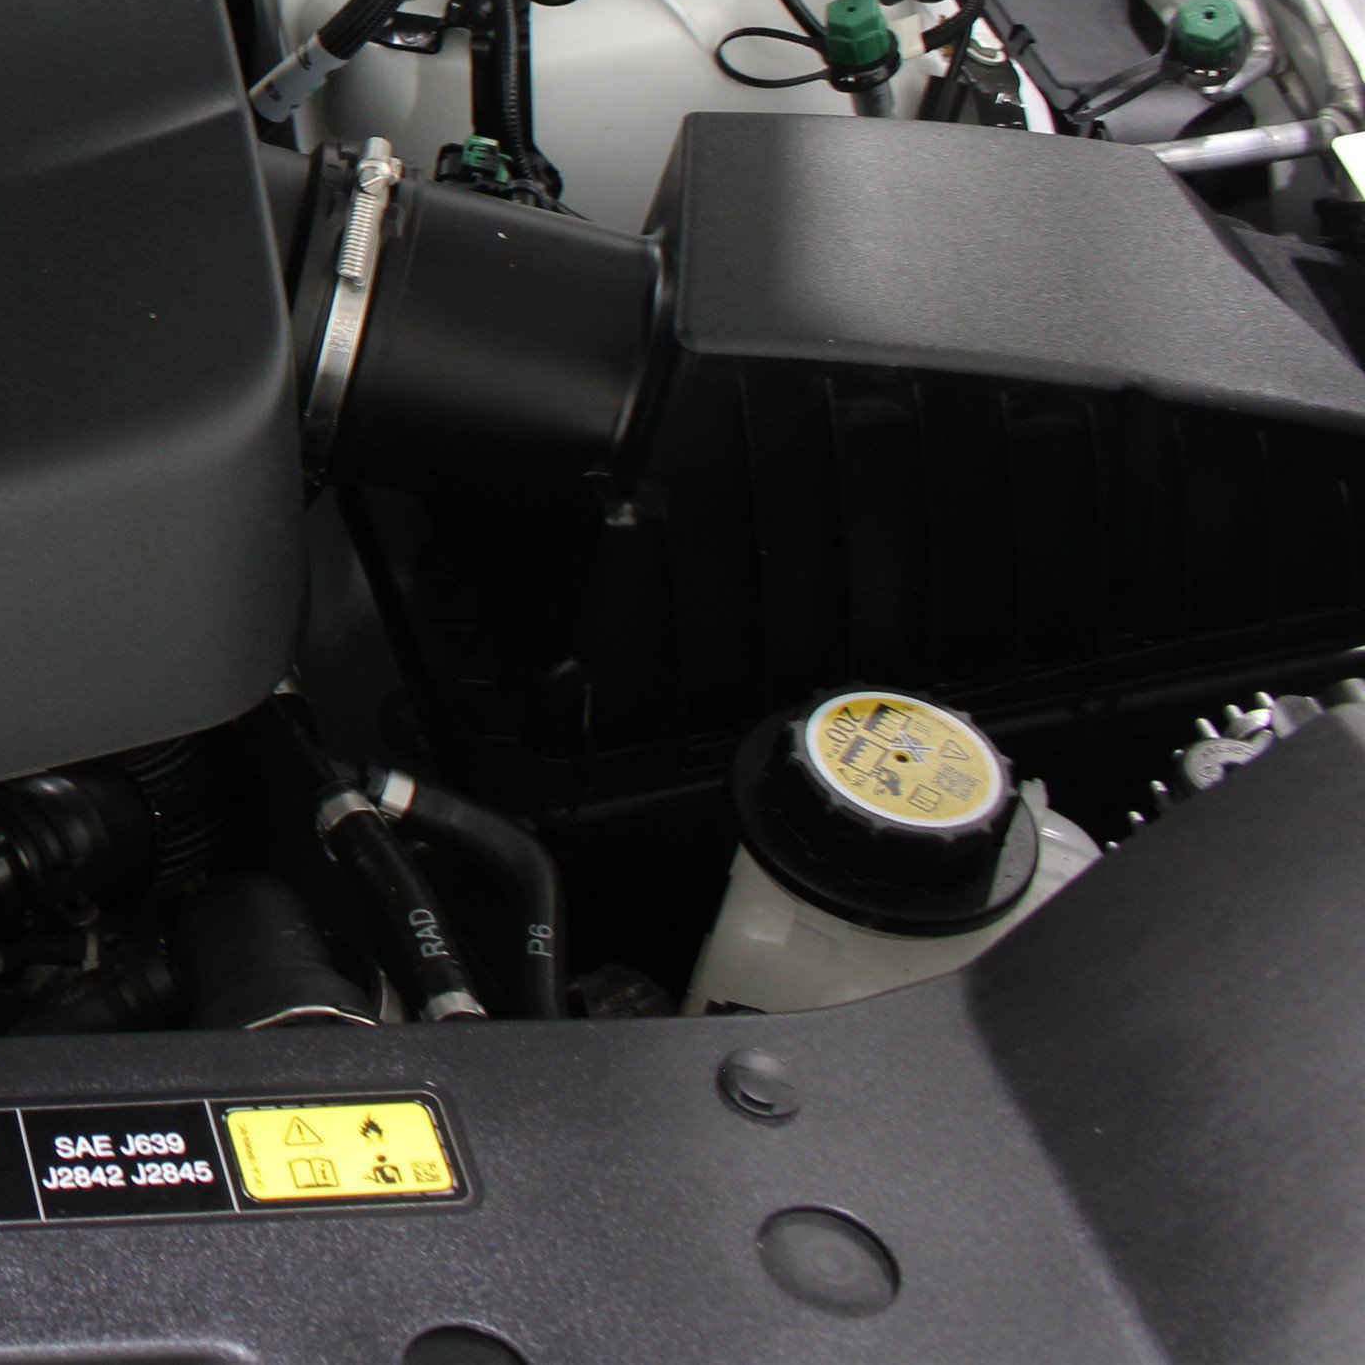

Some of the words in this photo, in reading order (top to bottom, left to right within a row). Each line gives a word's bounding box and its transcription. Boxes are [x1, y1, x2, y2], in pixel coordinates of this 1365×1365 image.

[825, 706, 865, 744] 200
[408, 908, 451, 958] RAD
[527, 923, 554, 958] P6
[54, 1134, 116, 1159] SAE
[119, 1132, 186, 1157] J639
[41, 1163, 127, 1190] J2842
[130, 1160, 214, 1185] J2845
